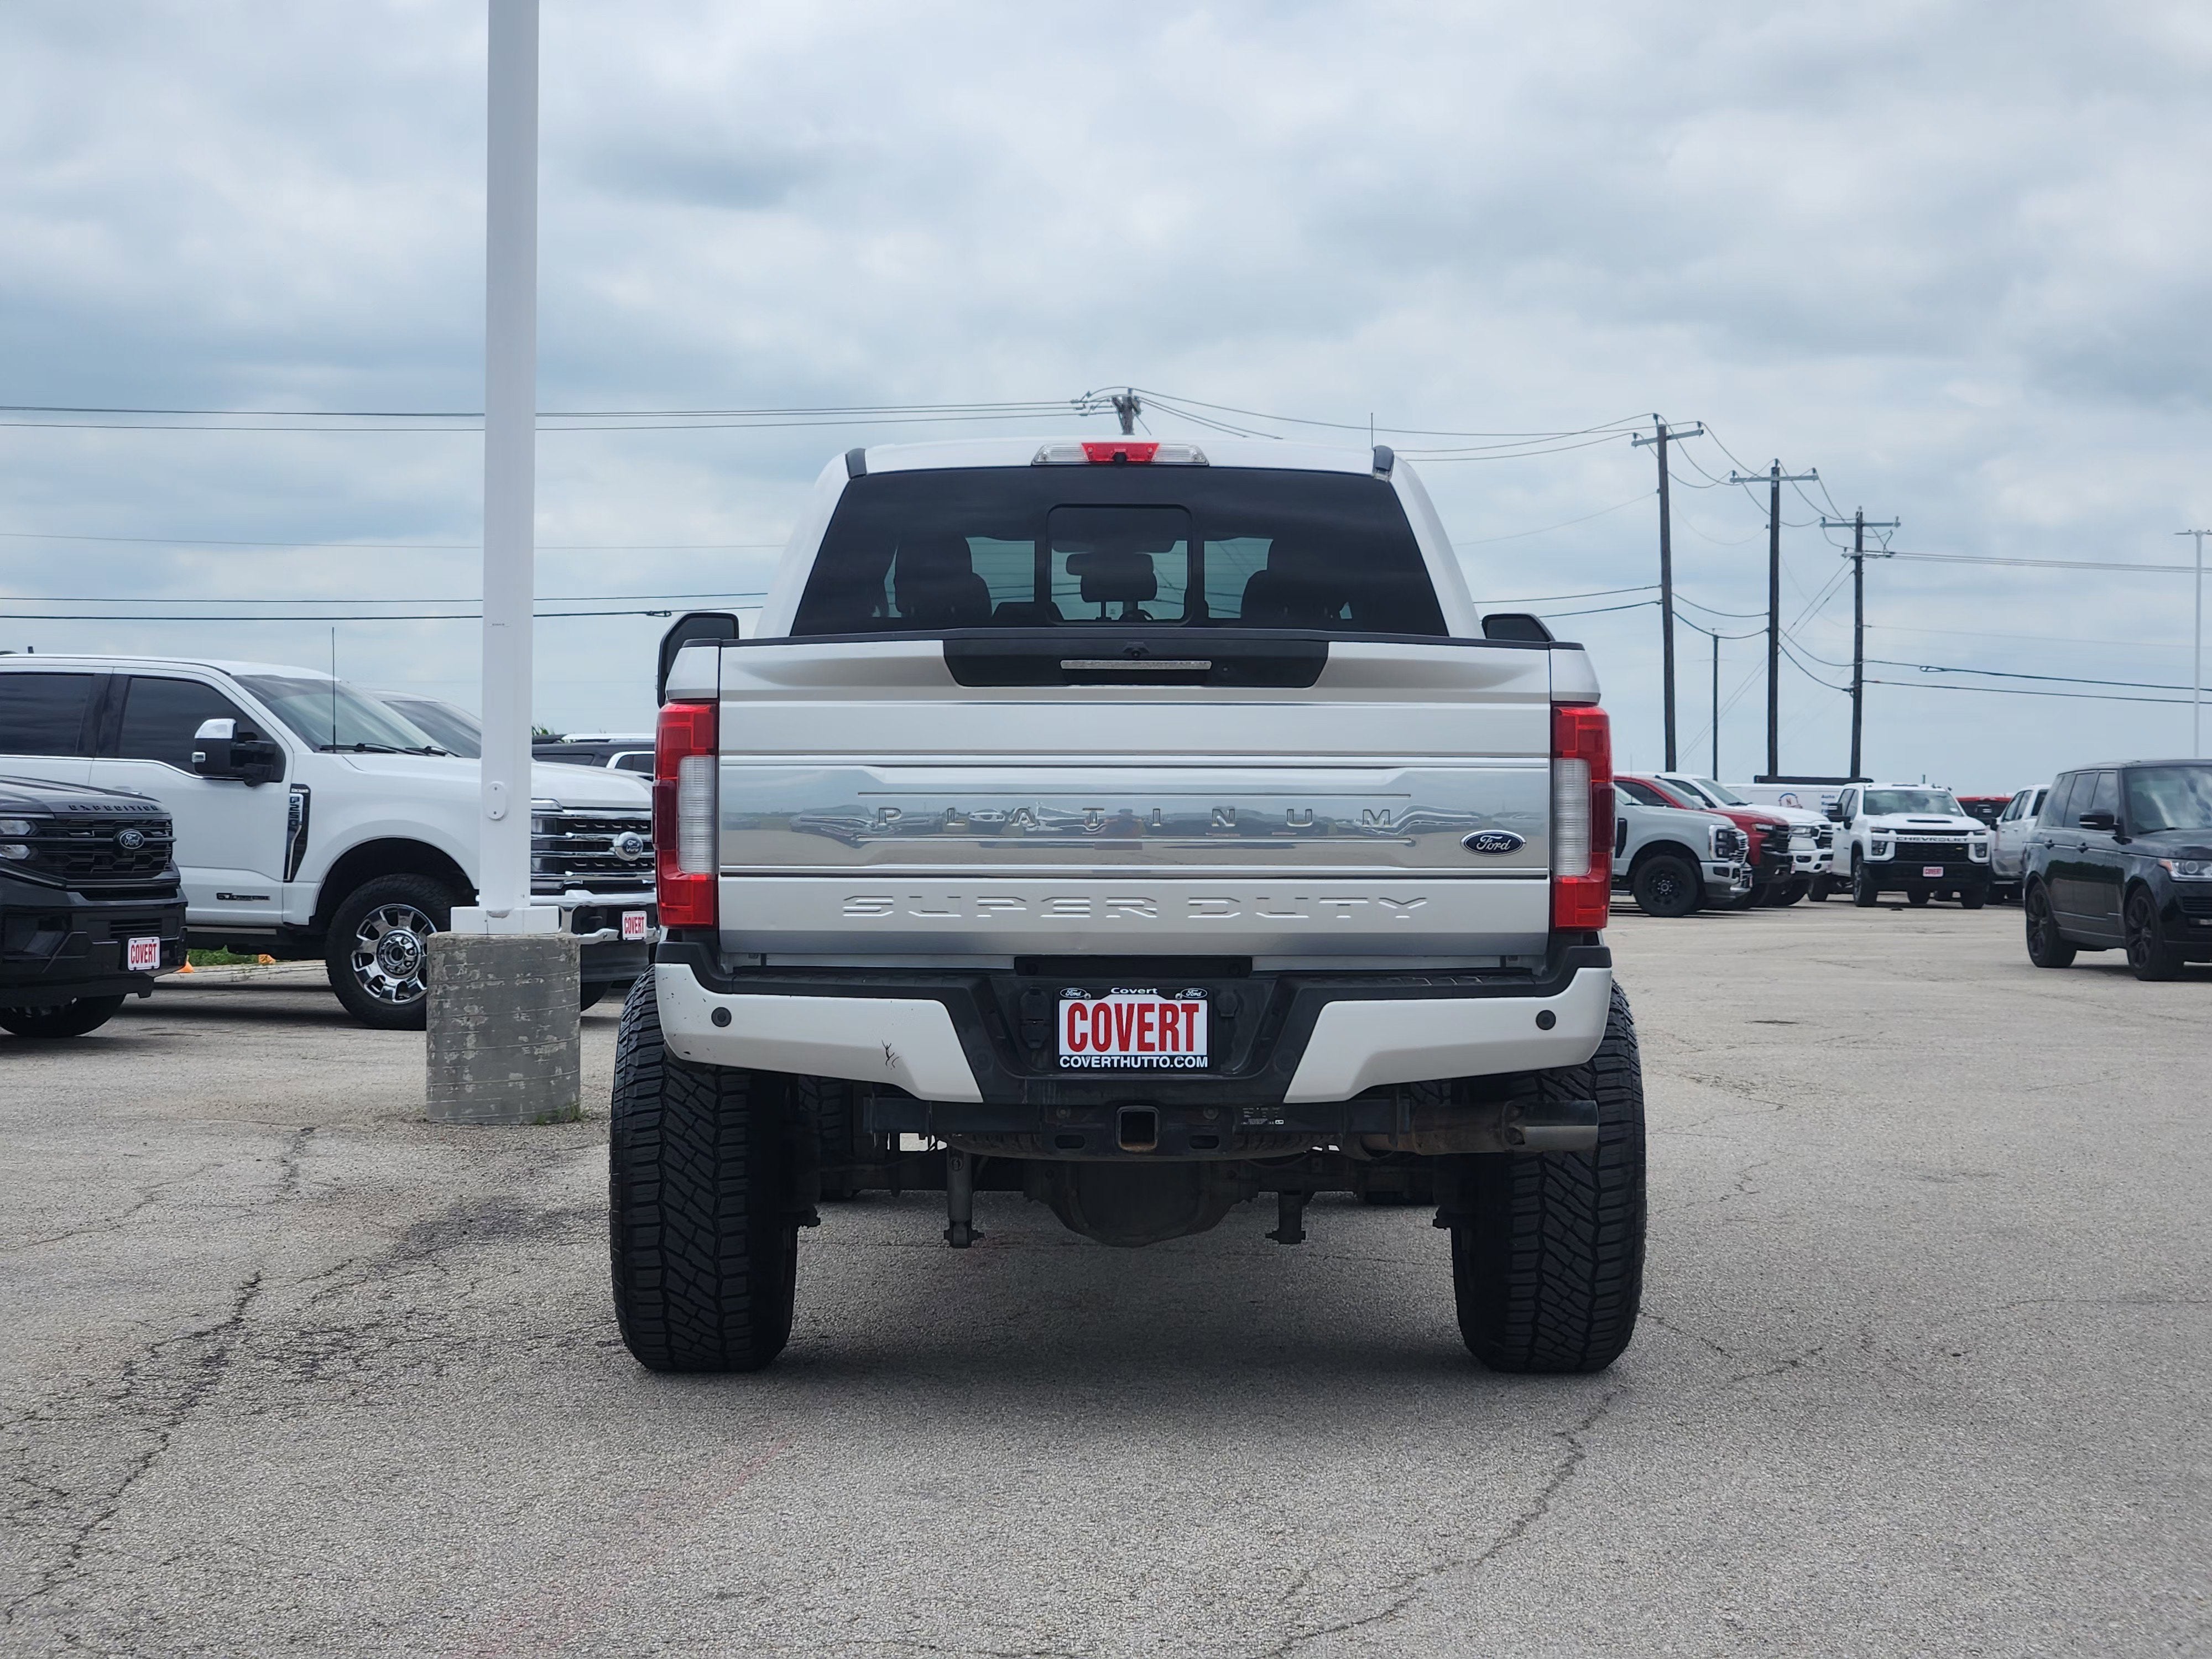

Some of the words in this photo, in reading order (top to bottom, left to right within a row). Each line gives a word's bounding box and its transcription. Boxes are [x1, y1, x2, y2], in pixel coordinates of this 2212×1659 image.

[878, 807, 1390, 827] PLATINUM
[1476, 835, 1511, 852] Ford
[843, 895, 1157, 918] SUPER
[1187, 897, 1427, 919] DUTY
[624, 917, 644, 934] COVERT
[131, 943, 156, 964] COVERT
[1067, 1002, 1199, 1052] COVERT
[1060, 1056, 1208, 1068] COVERTHUTTO.COM
